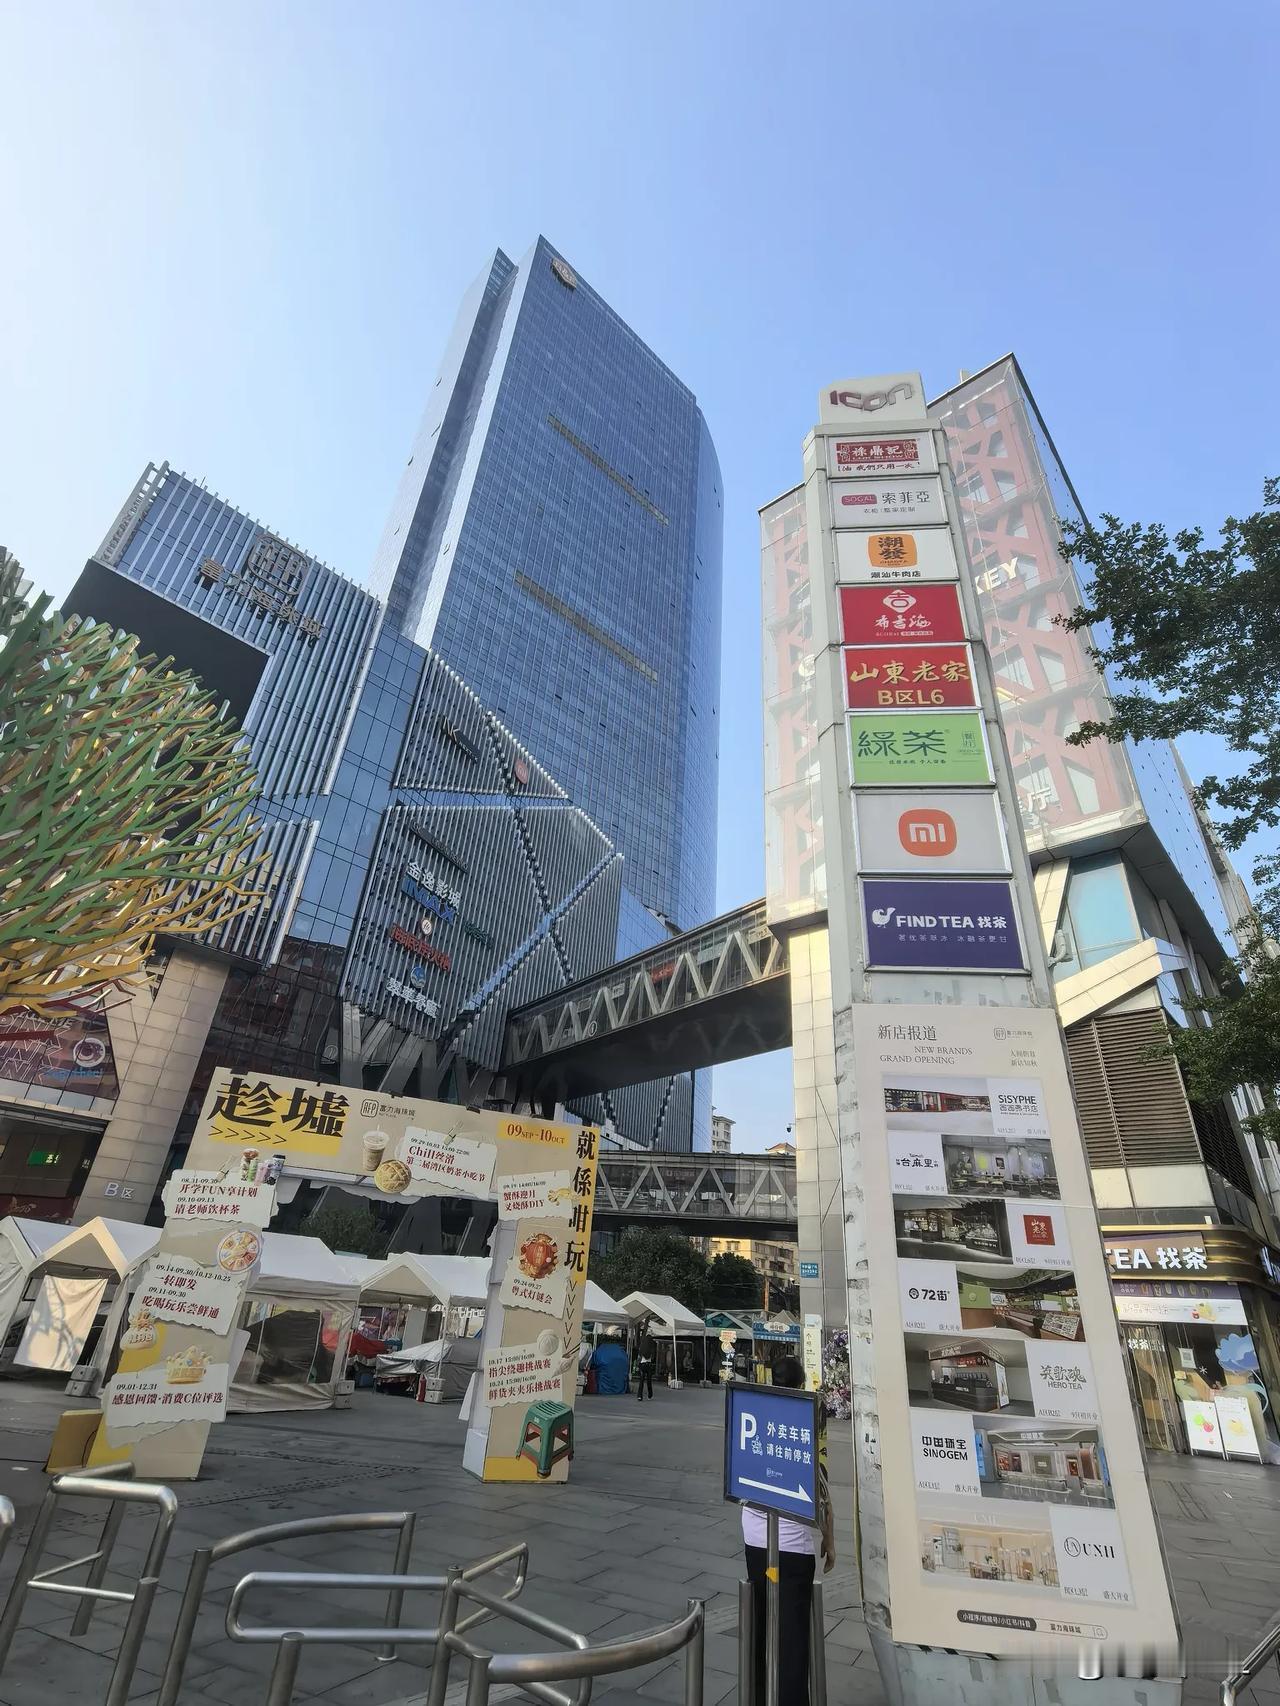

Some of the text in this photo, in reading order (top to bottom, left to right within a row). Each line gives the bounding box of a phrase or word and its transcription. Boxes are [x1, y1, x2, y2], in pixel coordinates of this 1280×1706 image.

[882, 491, 930, 504] 索菲亞
[871, 571, 920, 579] 潮汕牛肉店
[850, 660, 969, 685] 山東老家
[878, 689, 945, 705] B区L6
[407, 861, 461, 910] 金逸影城
[401, 874, 456, 926] IMAX
[896, 915, 1007, 929] FIND TEA 找茶
[878, 1024, 937, 1041] 新店报道
[914, 1046, 973, 1056] NEW BRANDS
[880, 1055, 955, 1065] GRAND OPENING
[380, 1104, 416, 1117] 富力海珠城
[407, 1155, 486, 1182] 第二届湾区奶茶小吃节
[104, 1182, 135, 1200] B区
[175, 1203, 241, 1215] 请老师饮杯茶
[1156, 1246, 1208, 1270] 找茶
[156, 1264, 231, 1282] 09.14-09.30/10.12-10.25
[154, 1274, 198, 1291] 一转即发
[148, 1286, 187, 1298] 09.11-09.30
[511, 1285, 553, 1305] 粤式灯谜会
[921, 1289, 948, 1301] 72街
[142, 1295, 220, 1319] 吃喝玩乐尝鲜通
[116, 1383, 158, 1391] 09.01-12.31
[1047, 1380, 1083, 1390] HERO TEA
[740, 1412, 757, 1451] P
[767, 1421, 811, 1445] 外卖车辆
[766, 1442, 812, 1465] 请往前停放
[923, 1447, 968, 1461] SINOGEM
[1050, 1623, 1082, 1634] 富力海珠城
